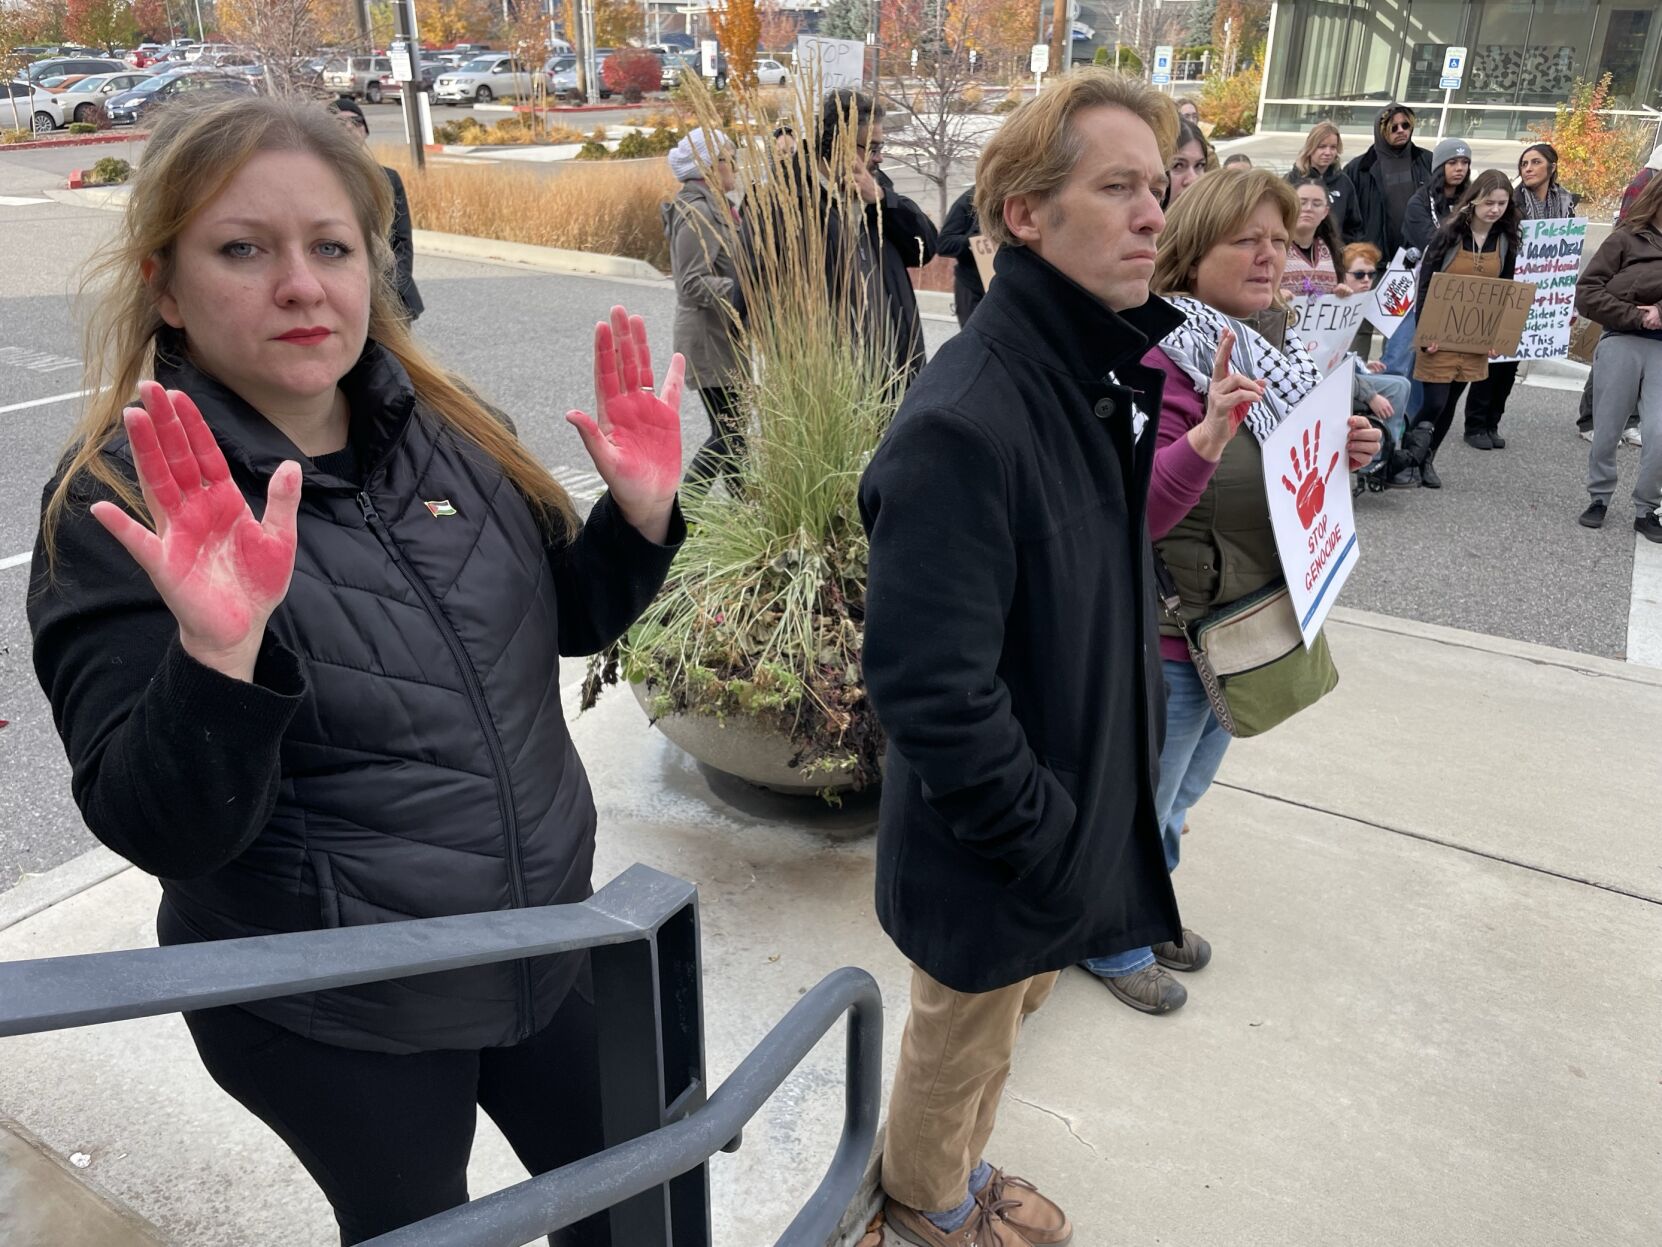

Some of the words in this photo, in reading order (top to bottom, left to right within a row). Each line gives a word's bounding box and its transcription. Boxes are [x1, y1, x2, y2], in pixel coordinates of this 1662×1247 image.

[1433, 279, 1528, 310] CEASEFIRE
[1288, 303, 1362, 331] SEFIRE
[1444, 305, 1503, 337] NOW
[1528, 334, 1554, 346] This
[1308, 514, 1327, 554] STOP
[1305, 523, 1342, 591] GENOCIDE
